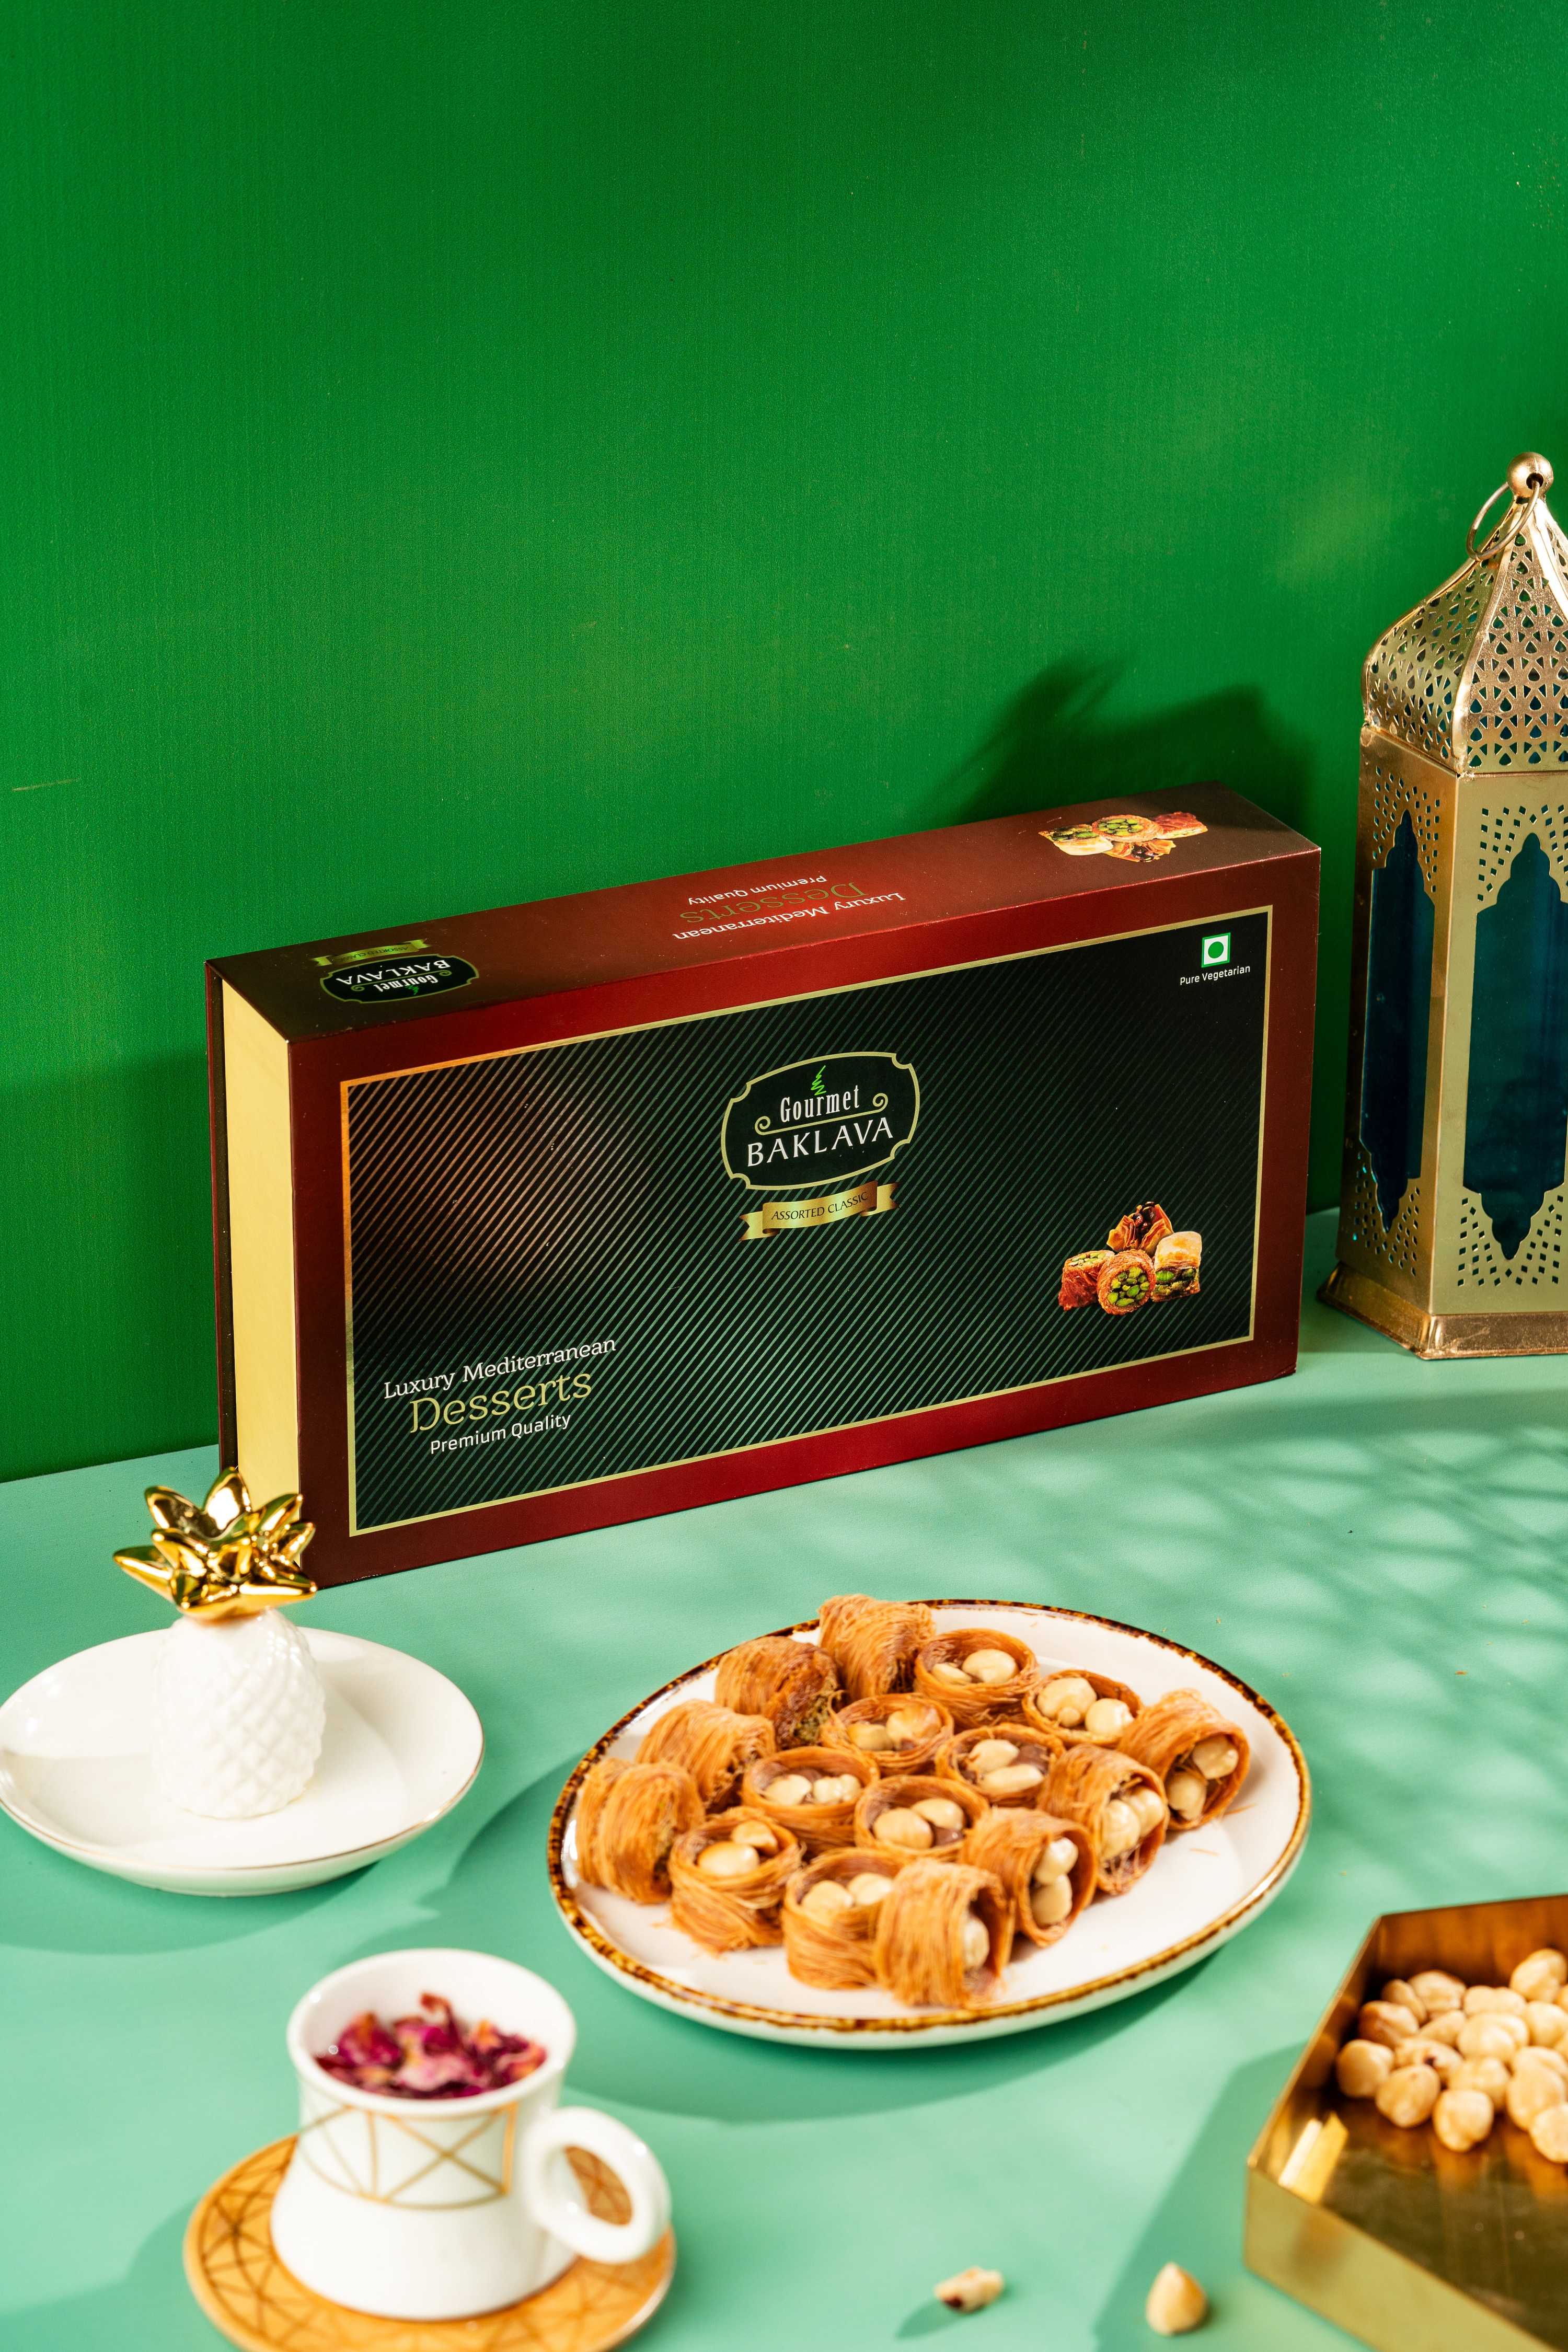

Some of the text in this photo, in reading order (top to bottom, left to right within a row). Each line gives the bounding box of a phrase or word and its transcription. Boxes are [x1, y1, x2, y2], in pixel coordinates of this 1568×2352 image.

[679, 882, 870, 924] Desserts
[687, 875, 827, 906] Premium Quality
[672, 892, 907, 940] Luxury Mediterranean
[335, 959, 451, 985] BAKLAVA
[373, 974, 439, 993] Gourmet
[1180, 966, 1251, 986] Pure Vegetarian
[780, 1085, 860, 1123] Gourmet
[747, 1117, 894, 1167] BAKLAVA
[771, 1191, 869, 1220] ASSORTED CLASSIC
[384, 1339, 617, 1399] Luxury Mediterranean
[409, 1373, 592, 1433] Desserts
[431, 1414, 572, 1455] Premium Quality
